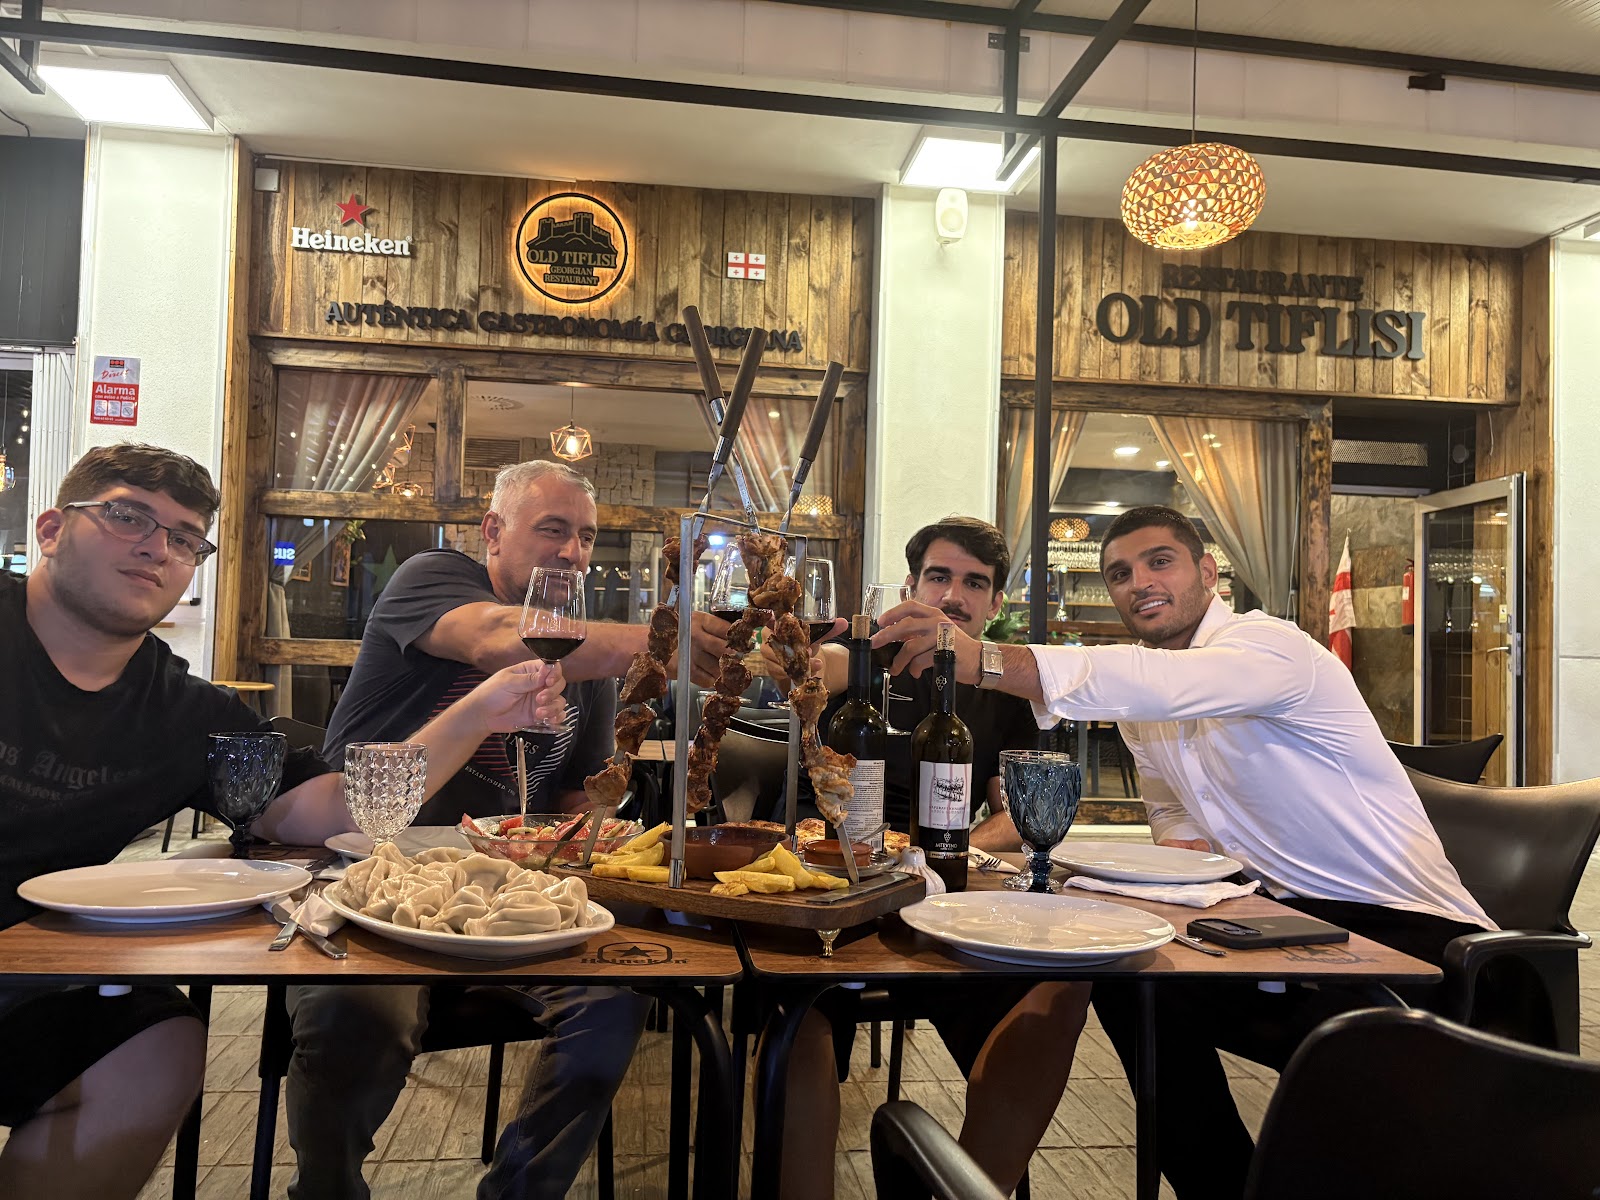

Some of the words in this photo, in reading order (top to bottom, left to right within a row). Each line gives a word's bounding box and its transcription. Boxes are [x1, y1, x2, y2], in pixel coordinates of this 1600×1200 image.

[291, 226, 411, 255] Heineken
[527, 249, 558, 263] OLD
[561, 250, 617, 268] TIFLISI
[550, 265, 593, 275] GEORGIAN
[544, 274, 598, 285] RESTAURANT
[1161, 264, 1364, 301] RESTAURANTE
[325, 299, 472, 331] AUTÉNTICA
[477, 310, 660, 342] GASTRONOMÍA
[1096, 292, 1212, 347] OLD
[1225, 301, 1426, 360] TIFLISI
[95, 384, 135, 395] Alarma
